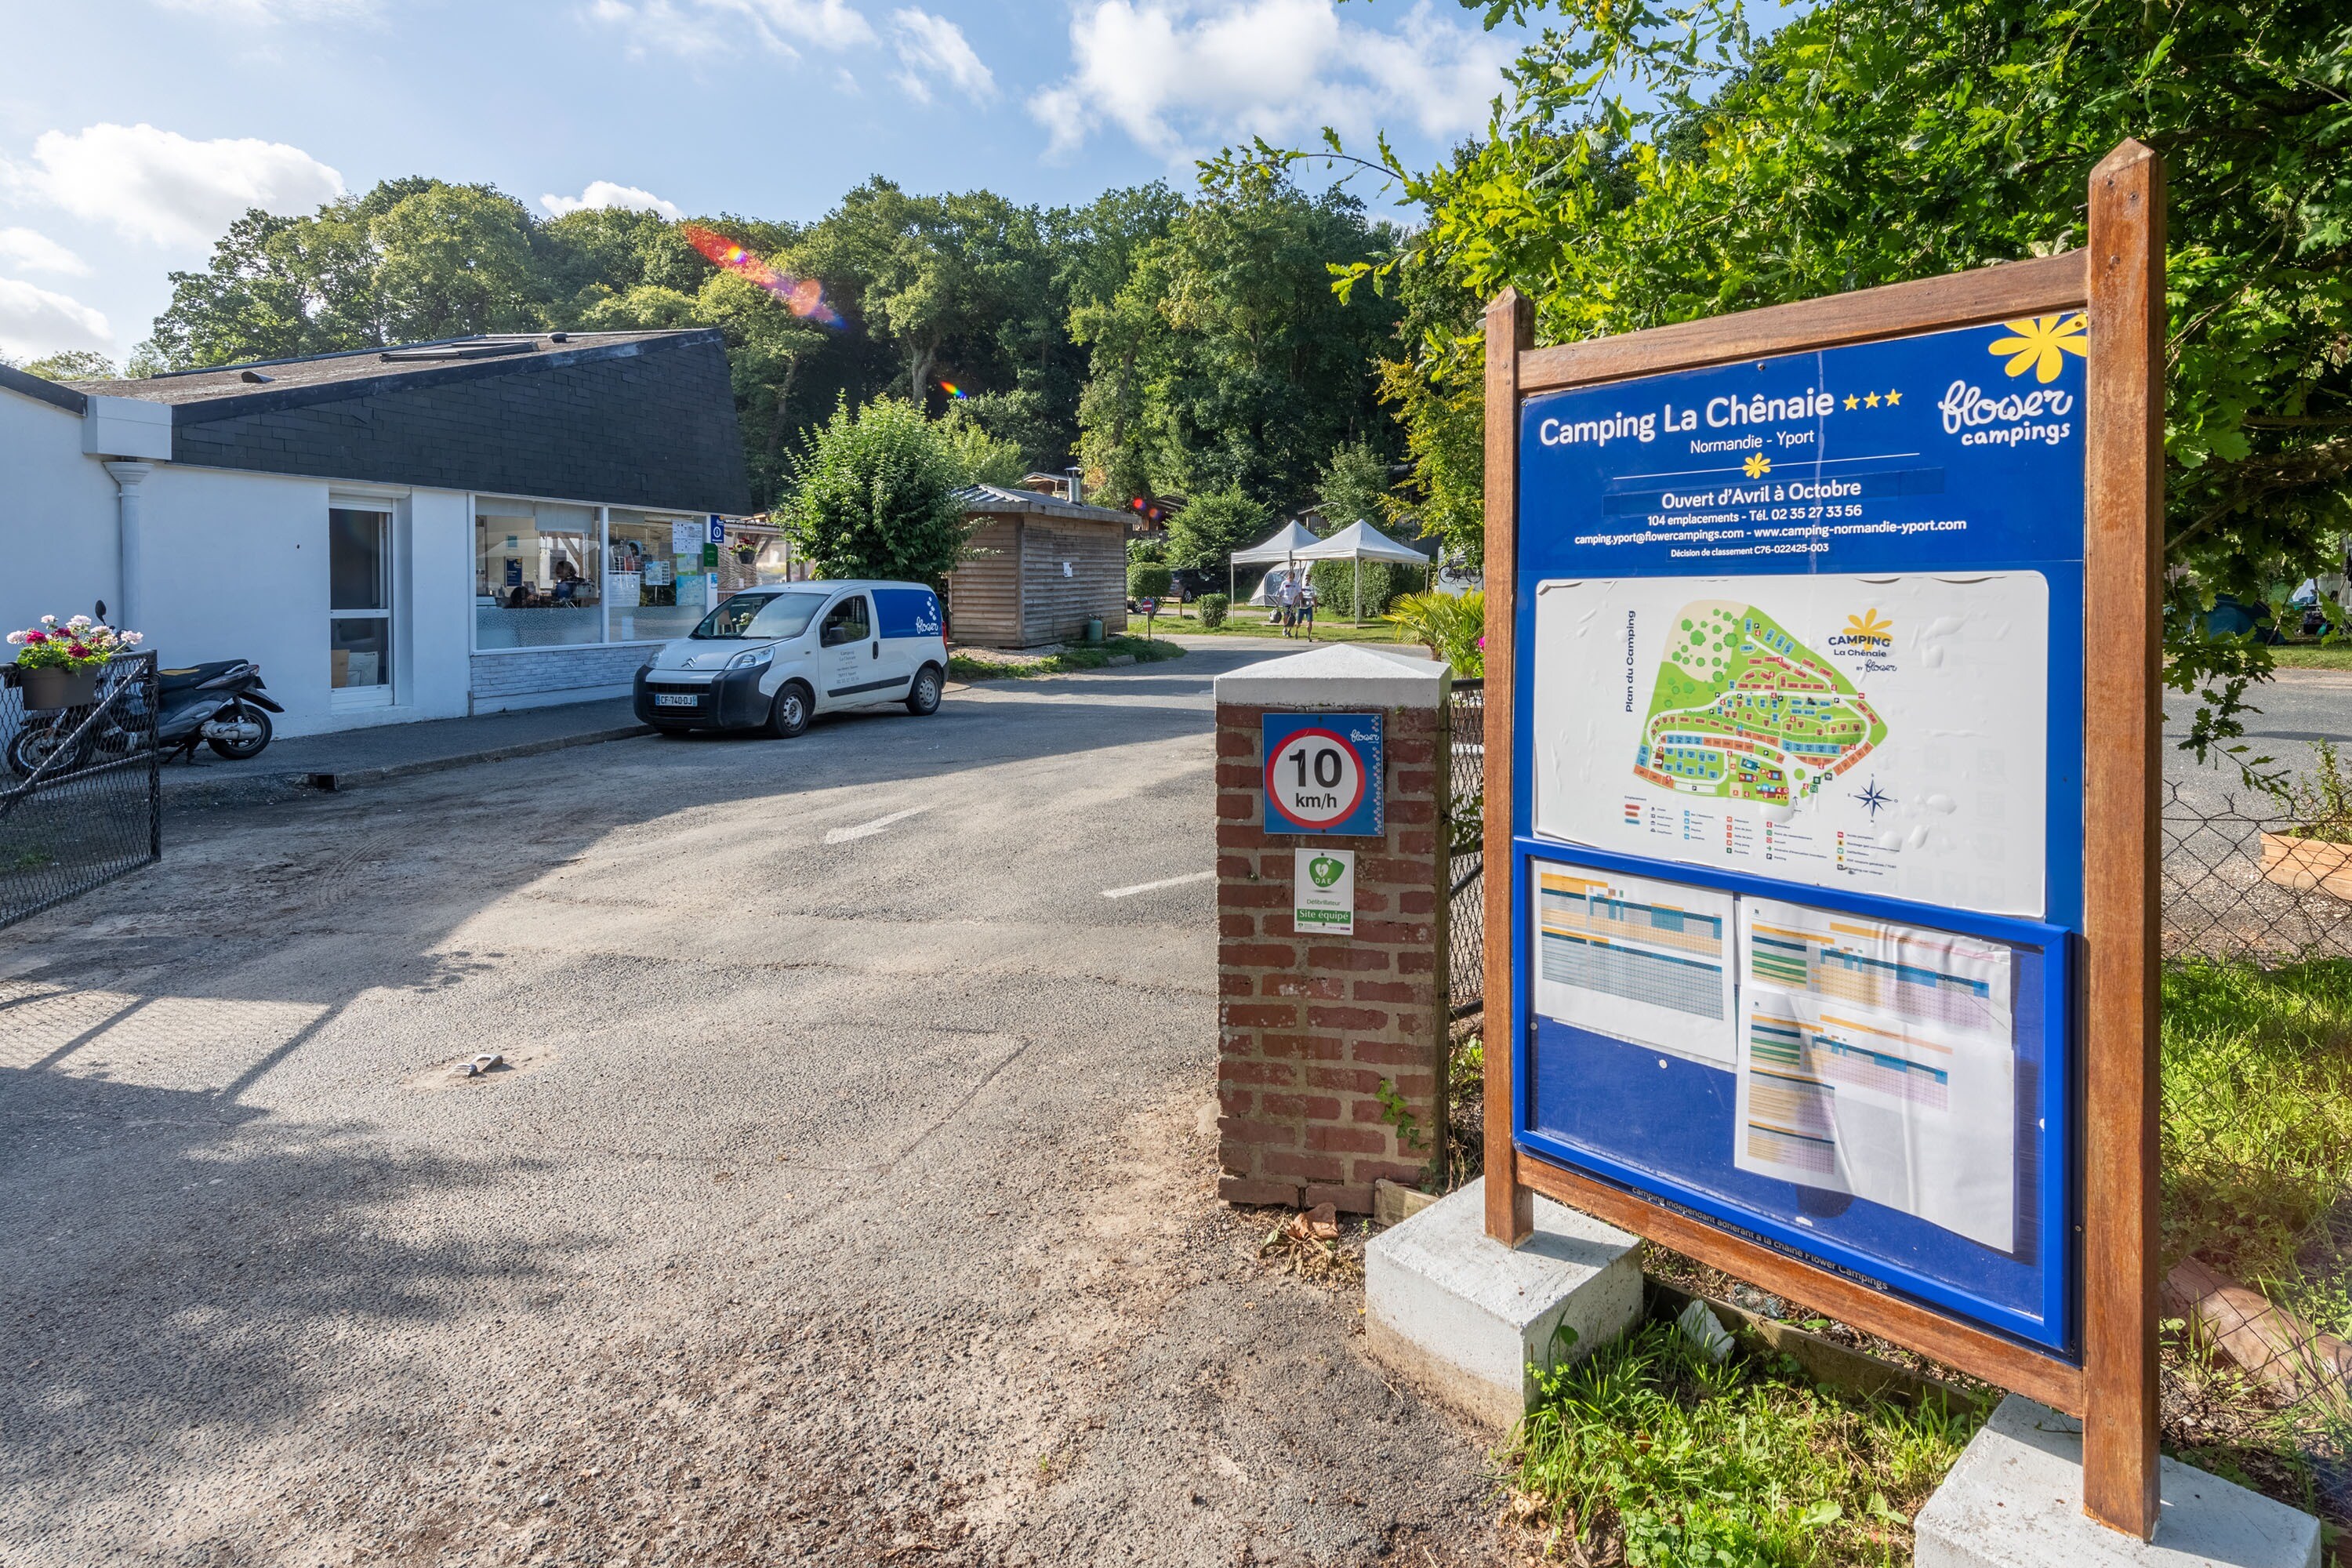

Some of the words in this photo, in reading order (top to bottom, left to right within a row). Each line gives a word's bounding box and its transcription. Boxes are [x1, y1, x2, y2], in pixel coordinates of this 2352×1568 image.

[1540, 412, 1657, 447] Camping
[1664, 404, 1697, 432] La
[1706, 387, 1835, 428] Chênaie
[1937, 379, 2074, 434] flower
[1690, 434, 1762, 454] Normandie
[1777, 430, 1815, 448] Yport
[1961, 421, 2071, 448] campings
[1661, 492, 1715, 510] Ouvert
[1718, 485, 1770, 506] d'Avril
[1773, 486, 1784, 501] à
[1788, 479, 1862, 501] Octobre
[1647, 515, 1666, 526] 104
[1668, 513, 1739, 528] emplacements
[1749, 510, 1769, 521] Tél.
[1771, 509, 1787, 520] 02
[1789, 507, 1806, 519] 35
[1808, 506, 1824, 518] 27
[1826, 506, 1842, 517] 33
[1845, 505, 1862, 517] 56
[1574, 528, 1744, 546] camping.yport@flowercampings.com
[1754, 520, 1967, 538] www.camping-normandie-yport.com
[1671, 548, 1700, 557] Décision
[1711, 547, 1753, 556] classement
[1754, 543, 1829, 554] C76-022425-003
[1626, 610, 1636, 666] Camping
[1828, 635, 1891, 648] CAMPING
[1626, 668, 1634, 684] du
[1865, 659, 1897, 673] flower
[1350, 729, 1380, 742] flower
[1289, 748, 1343, 789] 10
[1295, 793, 1338, 810] km/h
[1300, 909, 1316, 918] Site
[1318, 910, 1348, 922] équipé
[1632, 1187, 1665, 1206] camping
